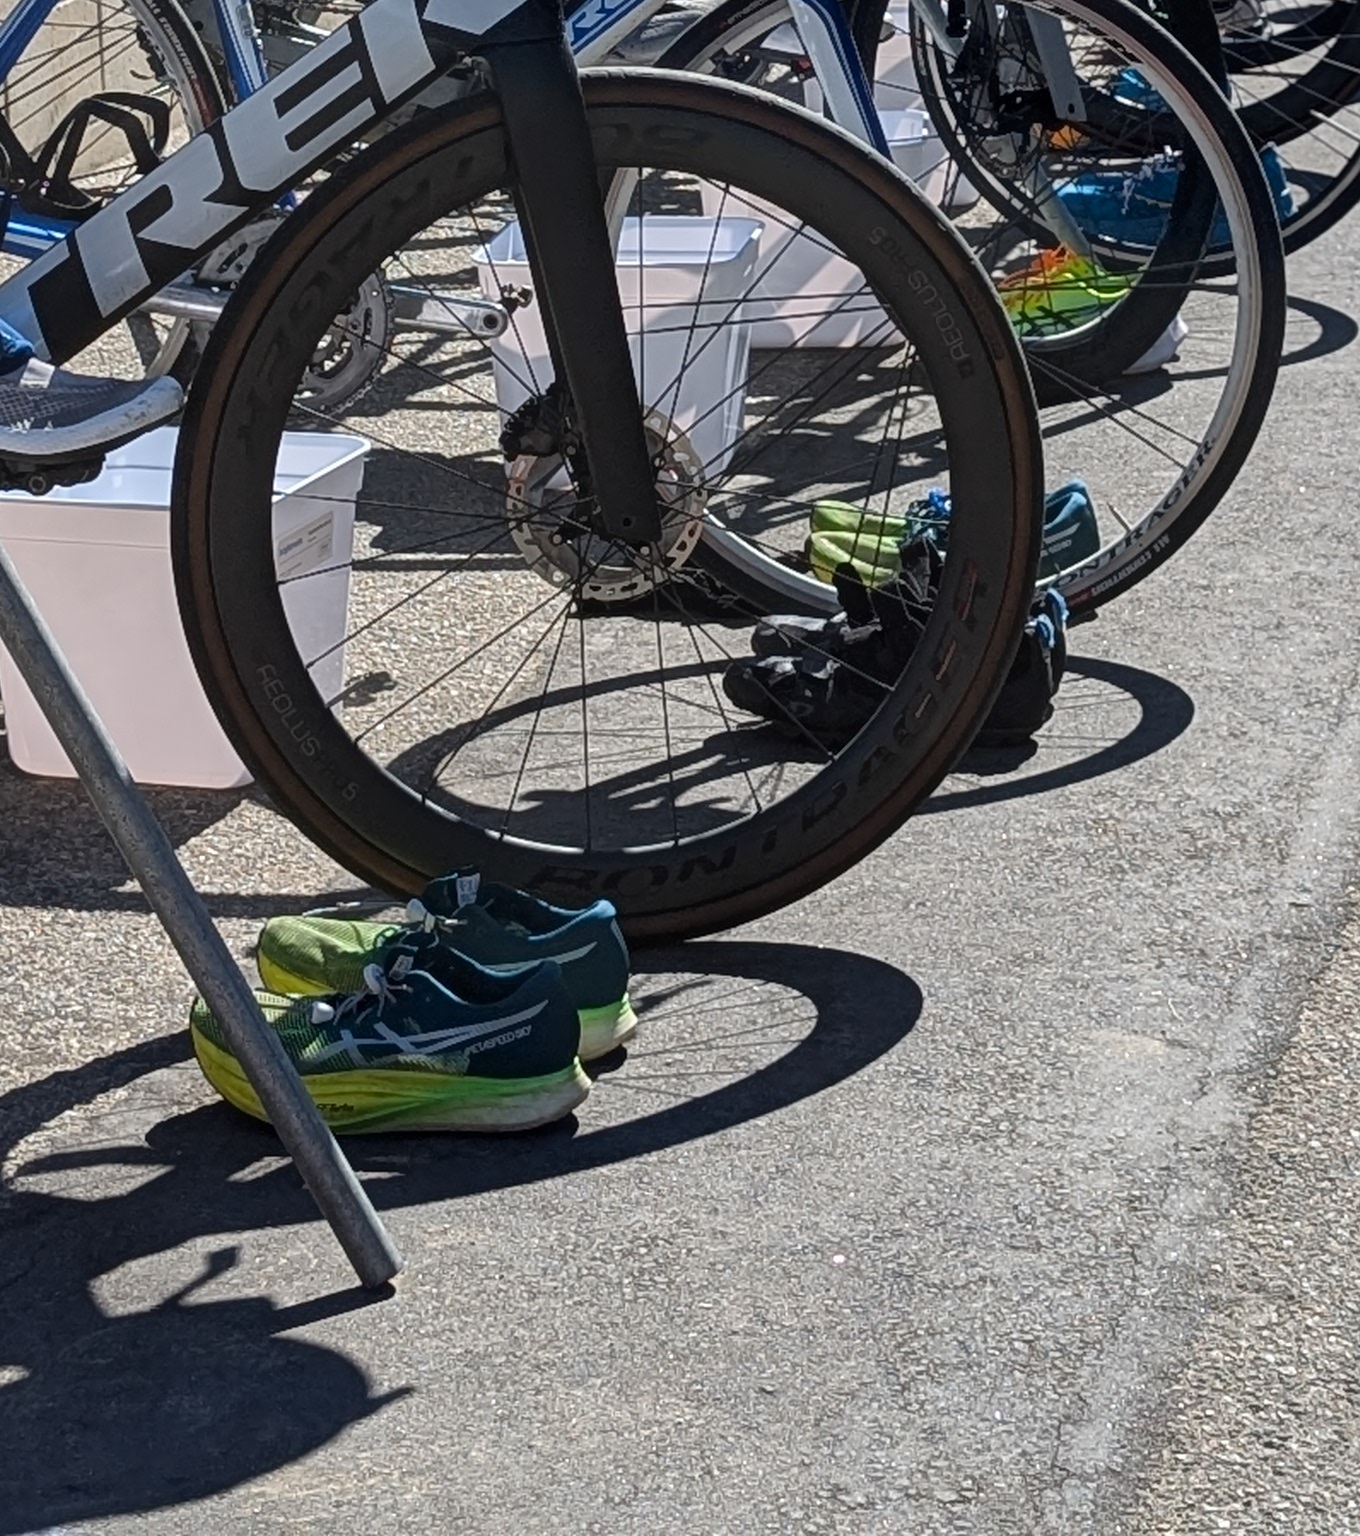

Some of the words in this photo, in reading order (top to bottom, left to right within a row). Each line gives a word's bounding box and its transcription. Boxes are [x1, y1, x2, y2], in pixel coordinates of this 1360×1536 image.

[906, 269, 971, 361] AEOLUS
[1054, 435, 1219, 588] ONTRAGER
[257, 663, 321, 756] AEOLUS
